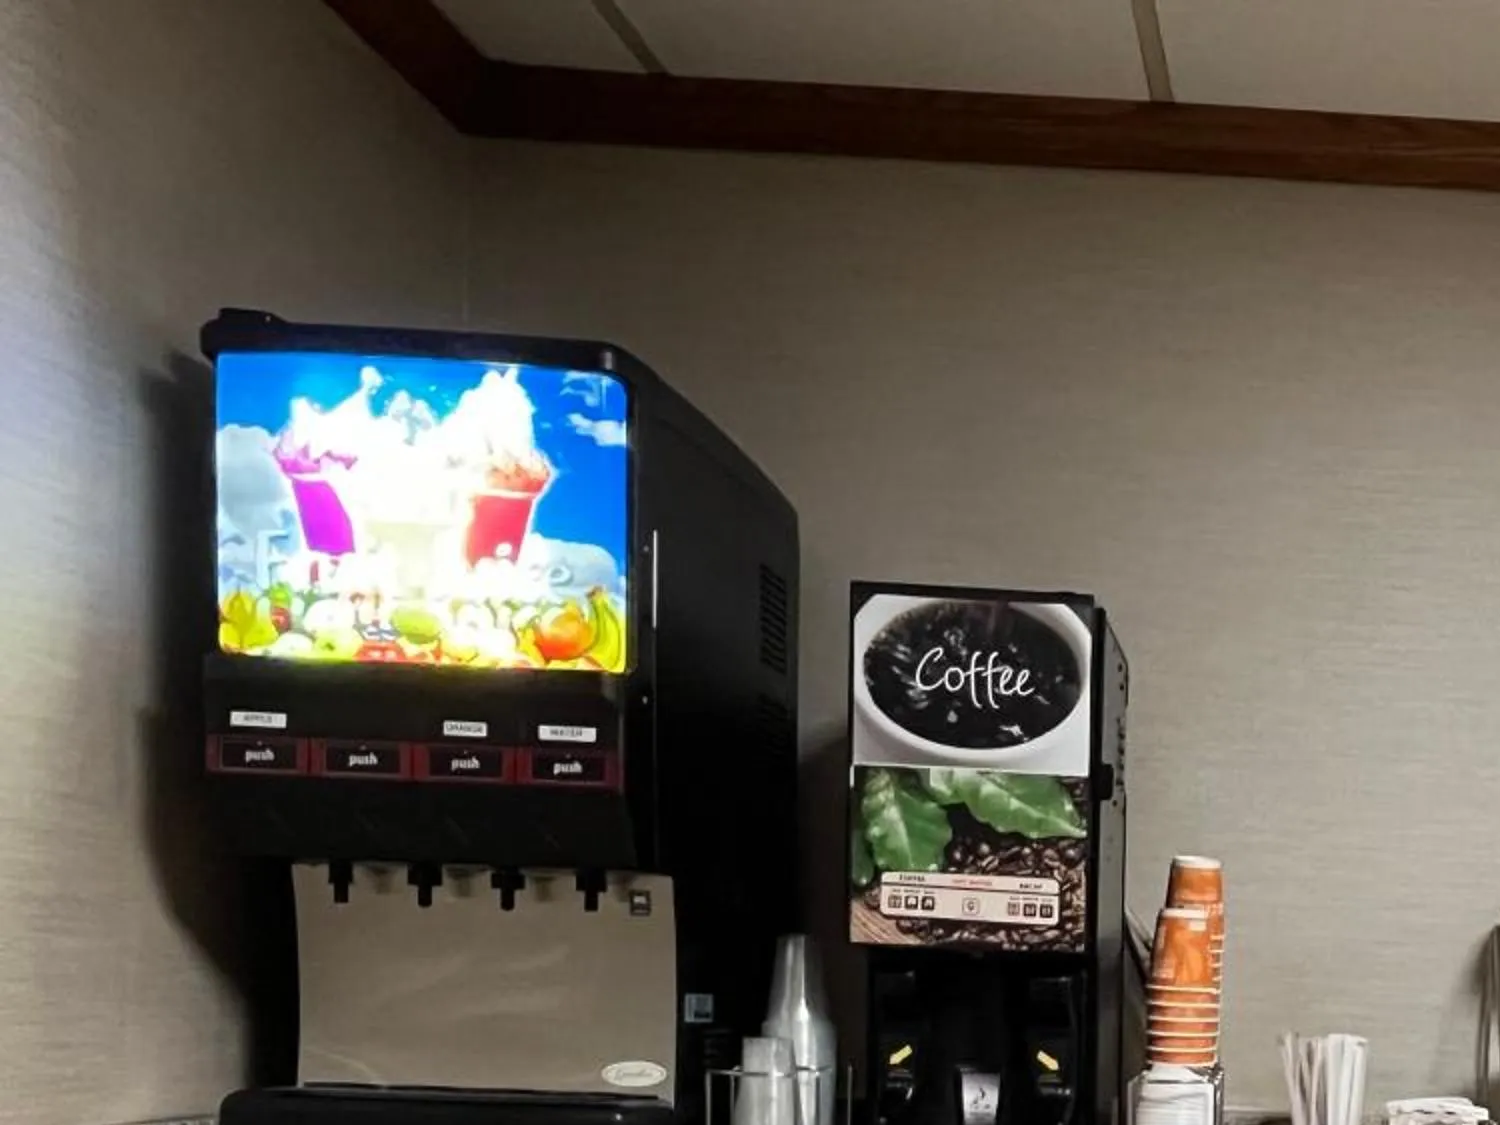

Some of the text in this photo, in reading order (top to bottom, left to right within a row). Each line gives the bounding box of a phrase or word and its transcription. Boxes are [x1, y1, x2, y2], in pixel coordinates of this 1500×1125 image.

[915, 647, 1035, 709] Coffee
[245, 748, 275, 763] push
[348, 752, 378, 767] push
[451, 756, 481, 772] push
[553, 761, 583, 775] push
